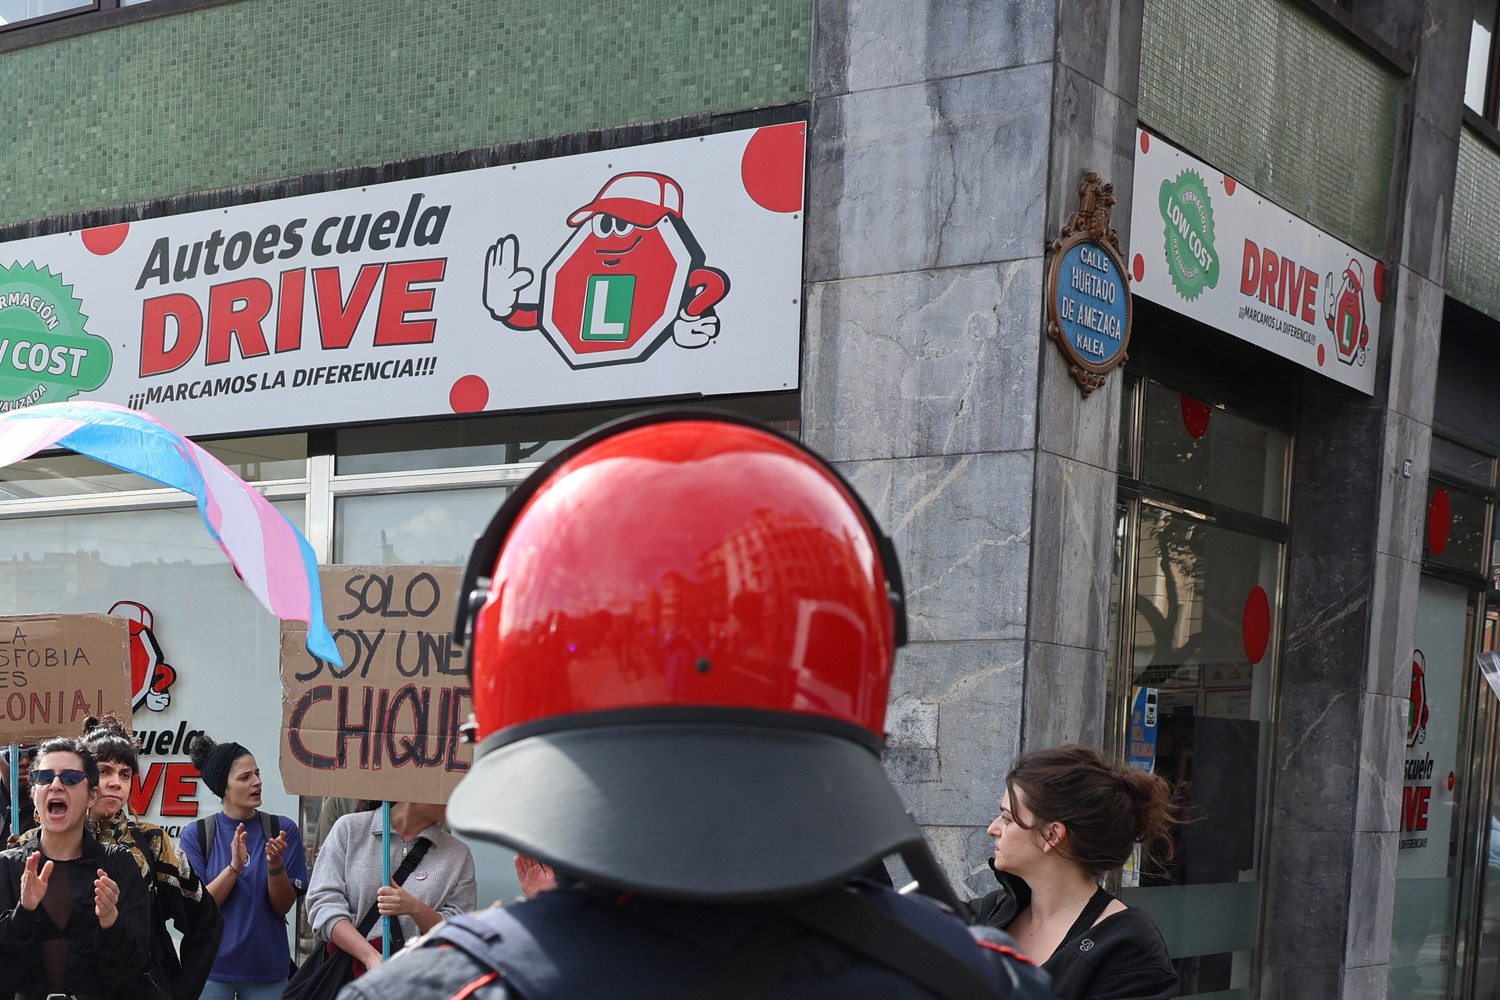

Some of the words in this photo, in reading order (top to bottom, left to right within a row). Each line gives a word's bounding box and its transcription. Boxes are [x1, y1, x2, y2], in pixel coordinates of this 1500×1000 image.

[1167, 196, 1191, 239] LOW
[1188, 230, 1213, 273] COST
[1080, 247, 1108, 273] CALLE
[1240, 238, 1319, 326] DRIVE
[590, 280, 625, 335] L
[1071, 266, 1116, 304] HURTADO
[138, 257, 448, 379] DRIVE
[1061, 296, 1074, 322] DE
[1076, 303, 1121, 341] AMEZAGA
[1275, 318, 1283, 333] LA
[11, 340, 88, 378] COST
[1076, 332, 1104, 357] KALEA
[260, 370, 286, 391] LA
[292, 356, 438, 388] DIFERENCIA!!!
[338, 571, 441, 621] SOLO
[288, 683, 472, 773] CHIQUE
